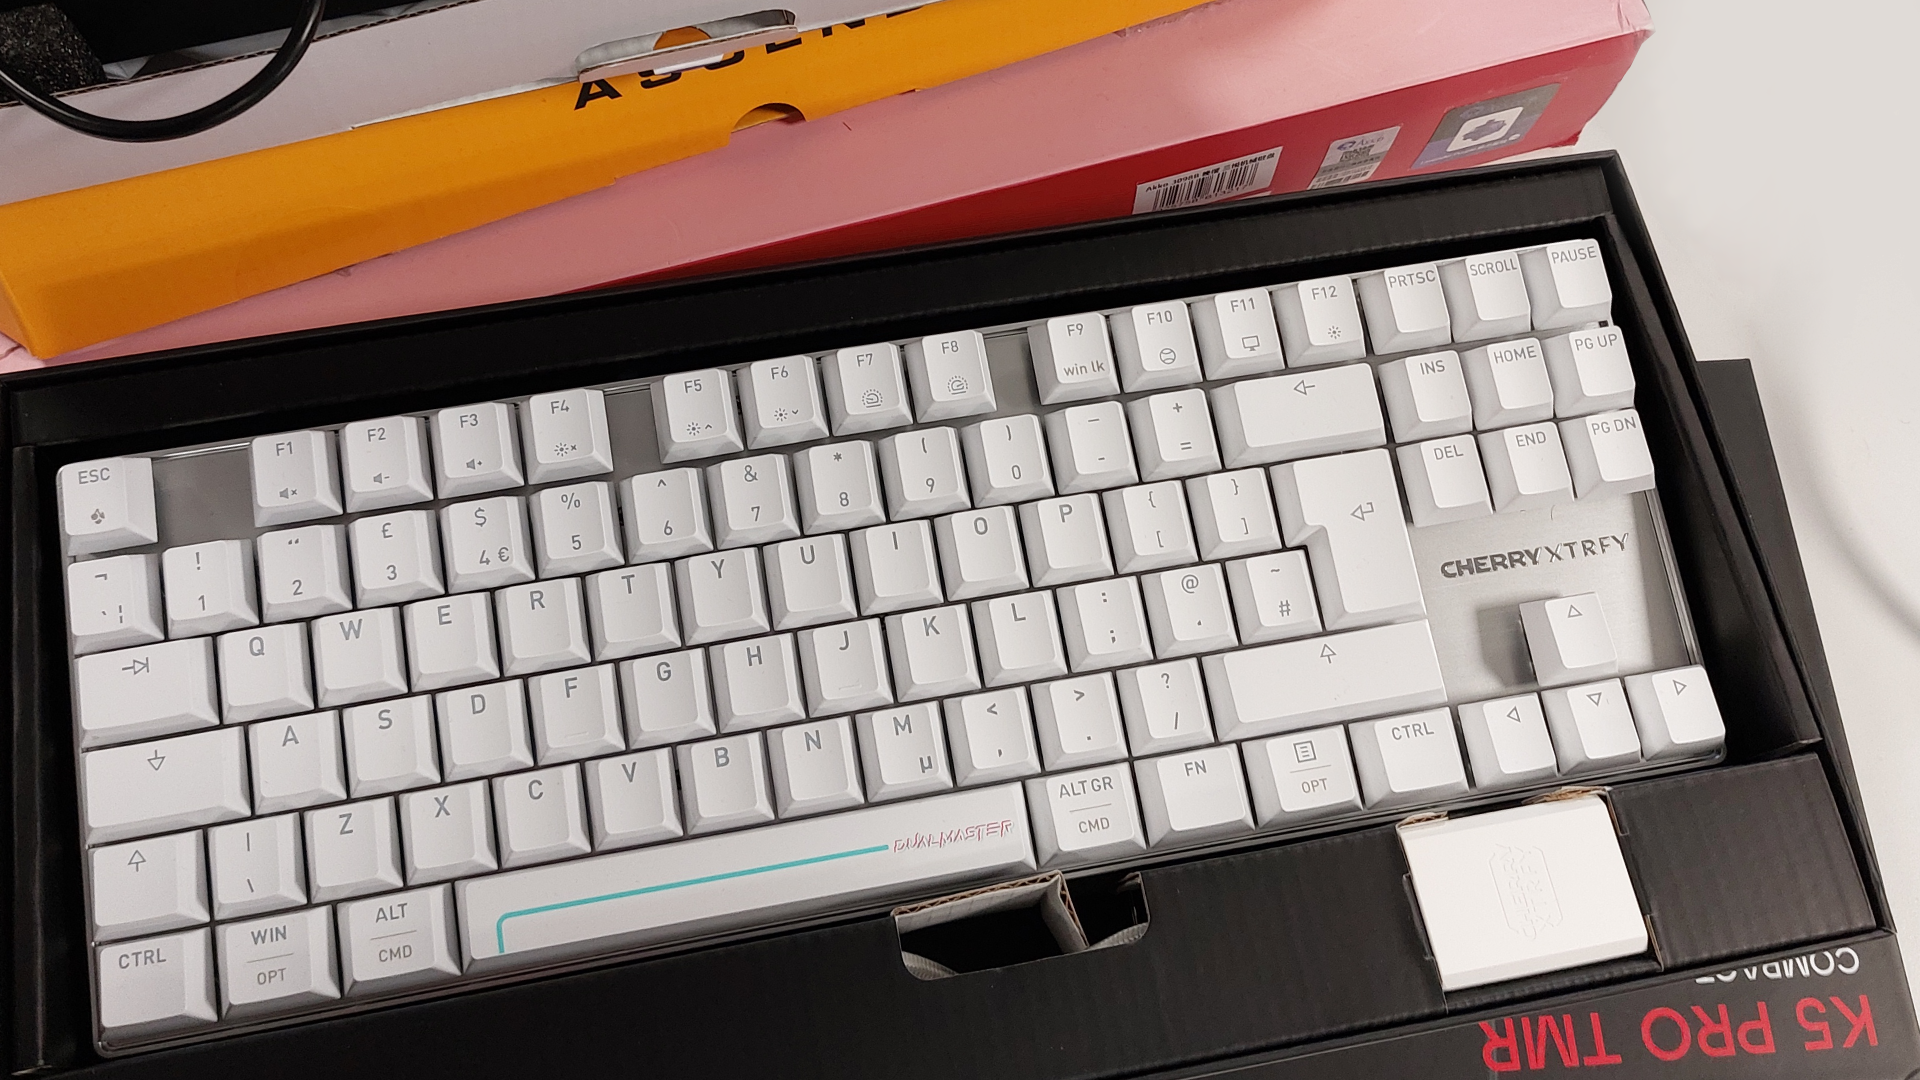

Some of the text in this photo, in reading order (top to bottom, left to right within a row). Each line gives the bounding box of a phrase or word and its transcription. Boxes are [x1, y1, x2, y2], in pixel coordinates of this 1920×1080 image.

[1552, 246, 1596, 263] PAUSE
[1470, 258, 1517, 276] SCROLL
[1389, 270, 1435, 287] PRTSC
[1312, 286, 1337, 300] F12
[1231, 298, 1255, 312] F11
[1147, 311, 1172, 324] F10
[1067, 323, 1083, 336] F9
[942, 341, 958, 354] F8
[1575, 334, 1617, 351] PG UP
[857, 353, 872, 367] F7
[1494, 346, 1536, 363] HOME
[771, 366, 788, 379] F6
[1064, 360, 1105, 376] win lk
[1420, 360, 1445, 375] INS
[684, 379, 702, 393] F5
[551, 400, 569, 414] F4
[1173, 403, 1182, 412] +
[460, 414, 478, 428] F3
[1592, 417, 1636, 435] PG DN
[368, 428, 386, 442] F2
[1006, 425, 1011, 441] )
[1516, 432, 1546, 447] END
[276, 442, 292, 456] F1
[922, 438, 927, 453] (
[1181, 442, 1192, 450] =
[1434, 445, 1464, 460] DEL
[78, 468, 110, 484] ESC
[745, 465, 758, 482] &
[1012, 465, 1021, 479] 0
[926, 478, 934, 493] 9
[1231, 479, 1238, 495] }
[561, 493, 580, 509] %
[840, 492, 849, 506] 8
[1149, 491, 1156, 508] {
[475, 507, 486, 527] $
[751, 506, 760, 521] 7
[1059, 504, 1072, 522] P
[382, 523, 393, 538] £
[664, 521, 672, 535] 6
[974, 517, 988, 535] O
[1241, 518, 1248, 534] ]
[572, 535, 581, 550] 5
[892, 532, 898, 549] I
[1157, 531, 1164, 547] [
[196, 552, 200, 570] !
[480, 547, 509, 565] 4 €
[800, 545, 815, 564] U
[387, 565, 397, 580] 3
[711, 559, 724, 578] Y
[293, 580, 303, 595] 2
[621, 574, 635, 594] T
[1181, 575, 1199, 593] @
[198, 595, 205, 611] 1
[530, 591, 545, 610] R
[1102, 593, 1107, 602] :
[438, 605, 452, 625] E
[1011, 603, 1026, 621] L
[1279, 600, 1290, 617] #
[339, 619, 362, 640] W
[923, 616, 940, 636] K
[839, 631, 849, 650] J
[1110, 630, 1115, 643] ;
[249, 637, 264, 656] Q
[747, 646, 762, 666] H
[657, 662, 671, 681] G
[565, 677, 577, 698] F
[1161, 673, 1169, 688] ?
[471, 694, 485, 714] D
[1074, 690, 1084, 701] >
[987, 703, 997, 715] <
[378, 709, 392, 729] S
[893, 715, 912, 735] M
[1175, 712, 1178, 729] /
[282, 726, 299, 747] A
[1392, 722, 1434, 740] CTRL
[805, 730, 821, 751] N
[714, 747, 729, 767] B
[622, 762, 636, 782] V
[1185, 760, 1206, 776] FN
[529, 780, 543, 800] C
[1302, 778, 1327, 793] OPT
[434, 795, 450, 817] X
[339, 813, 353, 835] Z
[1079, 818, 1109, 833] CMD
[893, 819, 1014, 853] DUALMASTER
[376, 903, 407, 923] ALT
[251, 925, 286, 945] WIN
[119, 948, 166, 969] CTRL
[379, 945, 412, 962] CMD
[257, 968, 286, 985] OPT
[1478, 993, 1880, 1072] K5 PRO TMR
